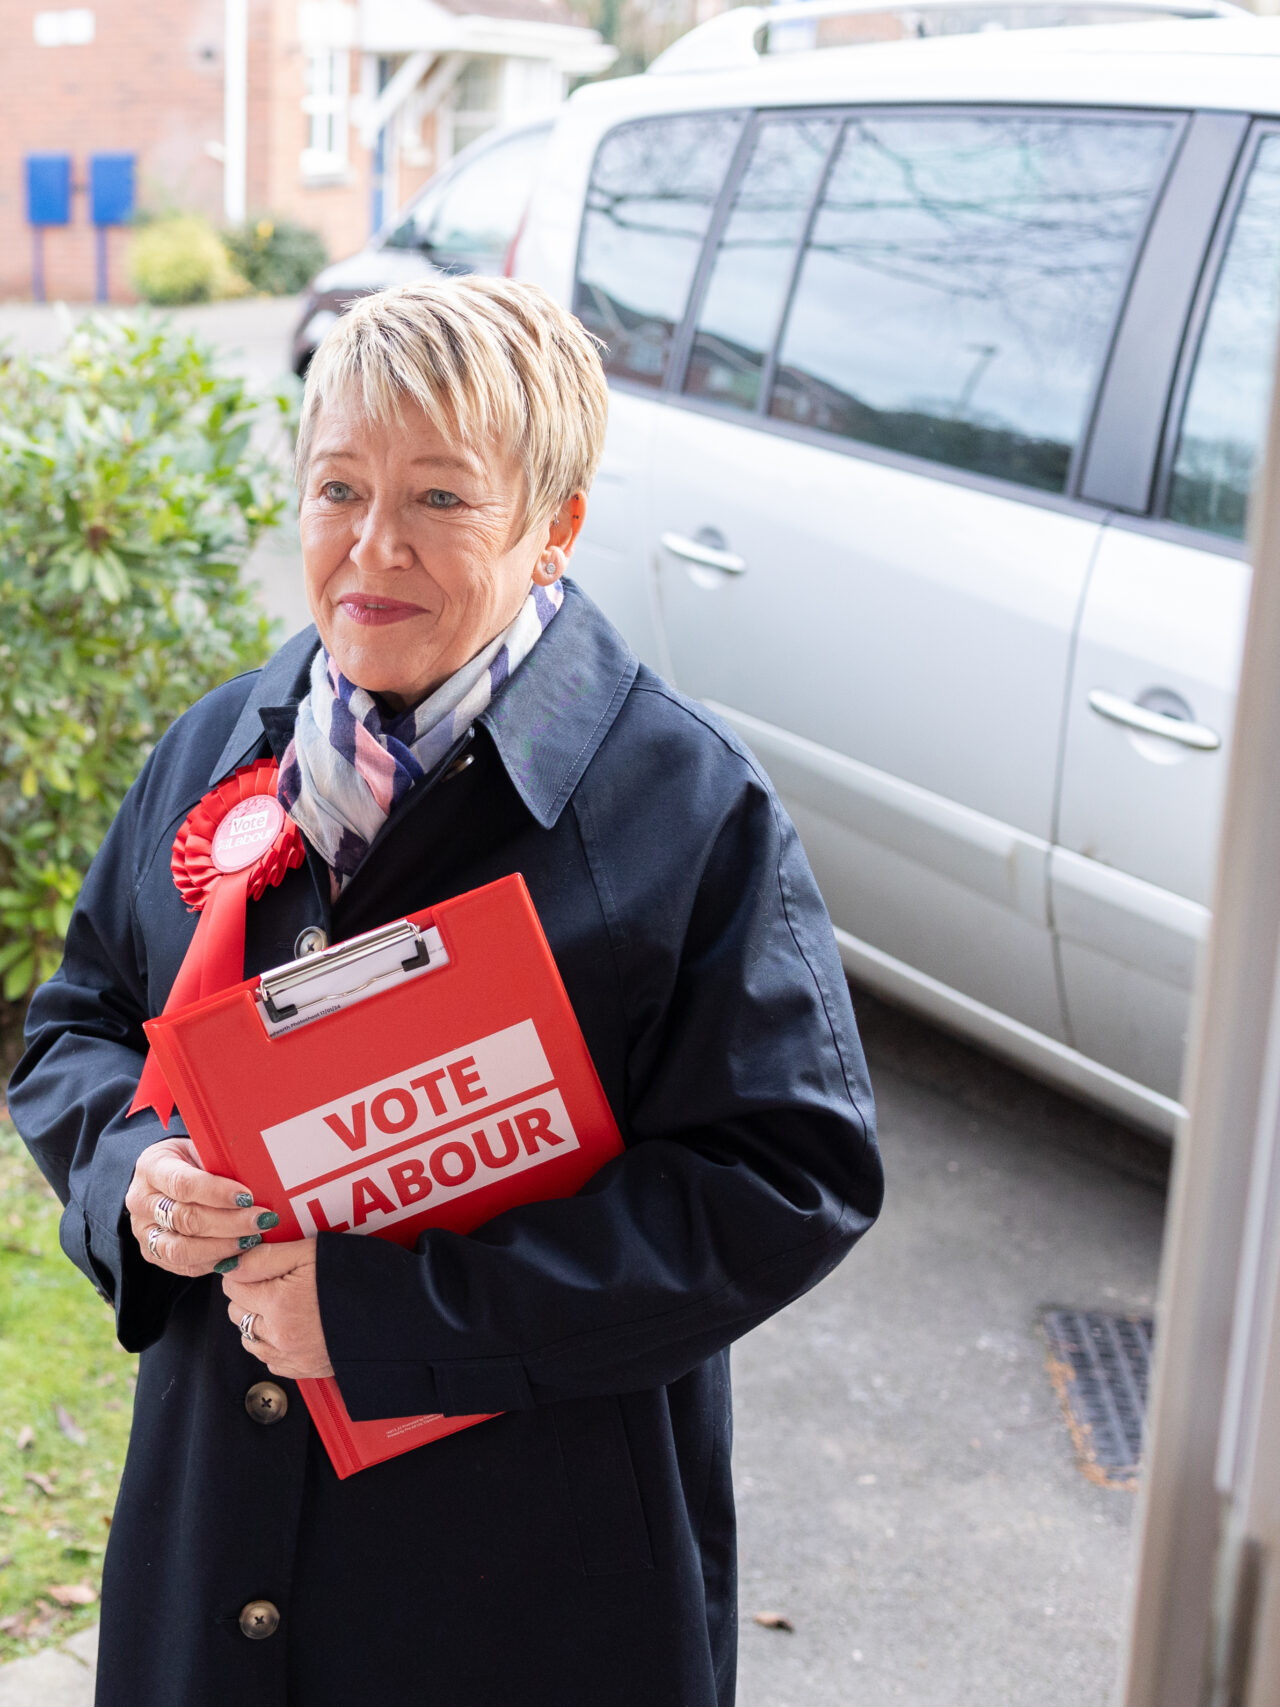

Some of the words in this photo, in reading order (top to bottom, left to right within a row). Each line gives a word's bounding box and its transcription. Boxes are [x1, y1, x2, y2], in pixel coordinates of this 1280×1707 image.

[230, 828, 275, 848] Labour
[233, 816, 266, 833] Vote
[322, 1055, 489, 1152] VOTE
[306, 1107, 566, 1234] LABOUR
